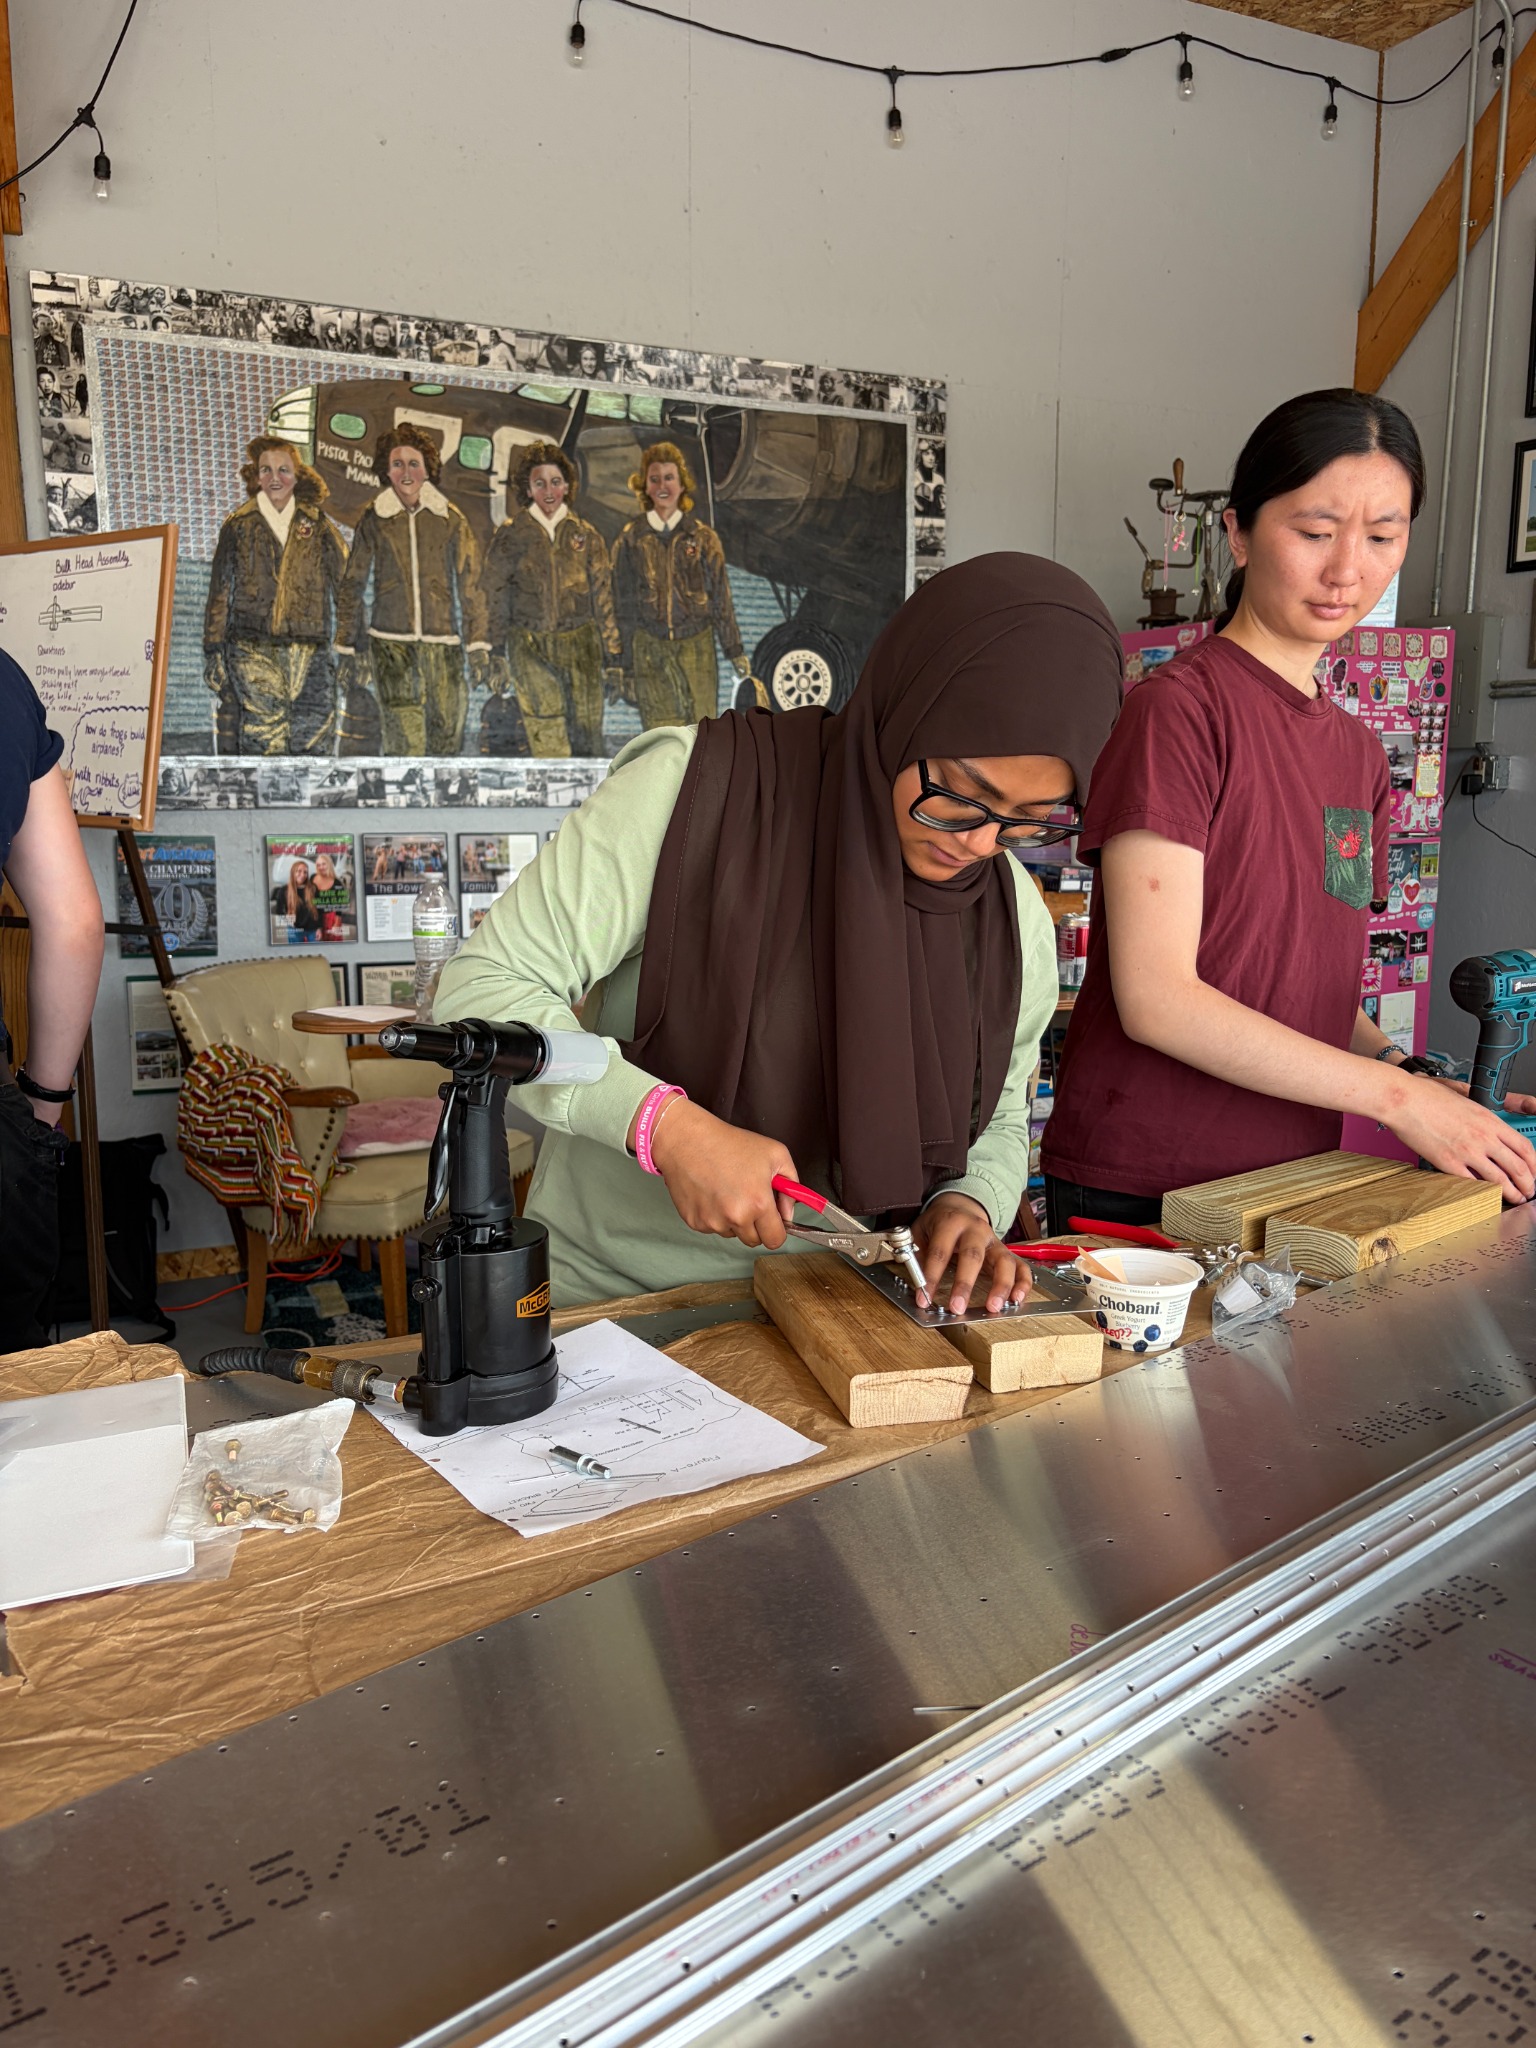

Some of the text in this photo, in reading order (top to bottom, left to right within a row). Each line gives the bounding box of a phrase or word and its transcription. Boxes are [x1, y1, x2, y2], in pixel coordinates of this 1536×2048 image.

[317, 440, 350, 463] PISTOL
[346, 465, 380, 488] MAMA
[75, 554, 94, 570] Head
[97, 550, 130, 568] Assembly
[85, 721, 146, 743] how do frogs build
[91, 741, 125, 758] airplanes?
[75, 766, 120, 788] with ribbits
[149, 864, 212, 875] CHAPTERS
[373, 884, 393, 893] The
[463, 882, 496, 892] Family
[649, 1092, 661, 1105] Girls
[1126, 1315, 1146, 1325] Yogurt
[670, 1456, 721, 1473] Figure-A
[1336, 1575, 1508, 1664] SB209
[1181, 1661, 1347, 1757] ASME
